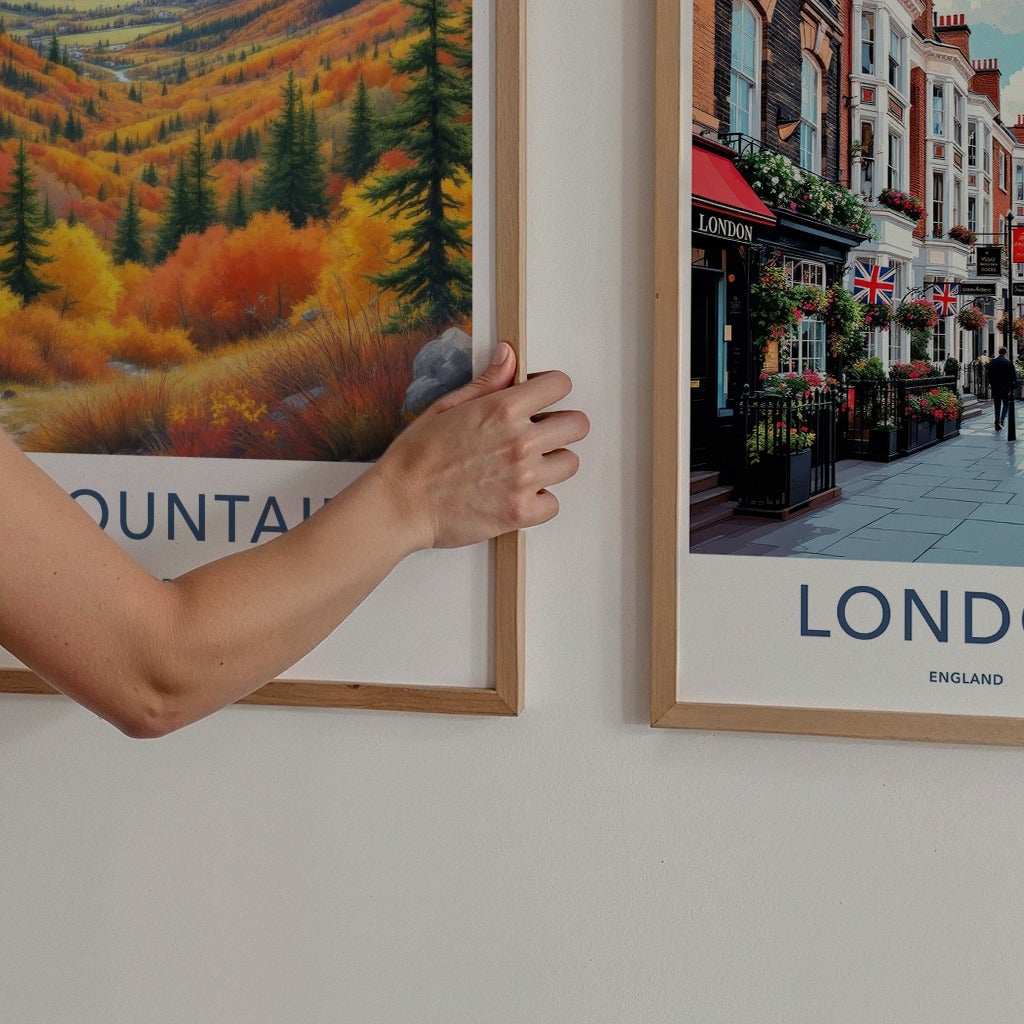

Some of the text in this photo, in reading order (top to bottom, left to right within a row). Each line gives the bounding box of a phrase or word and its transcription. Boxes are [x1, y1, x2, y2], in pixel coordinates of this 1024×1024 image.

[698, 213, 753, 242] LONDON
[800, 584, 1024, 645] LOND
[929, 671, 1004, 686] ENGLAND
